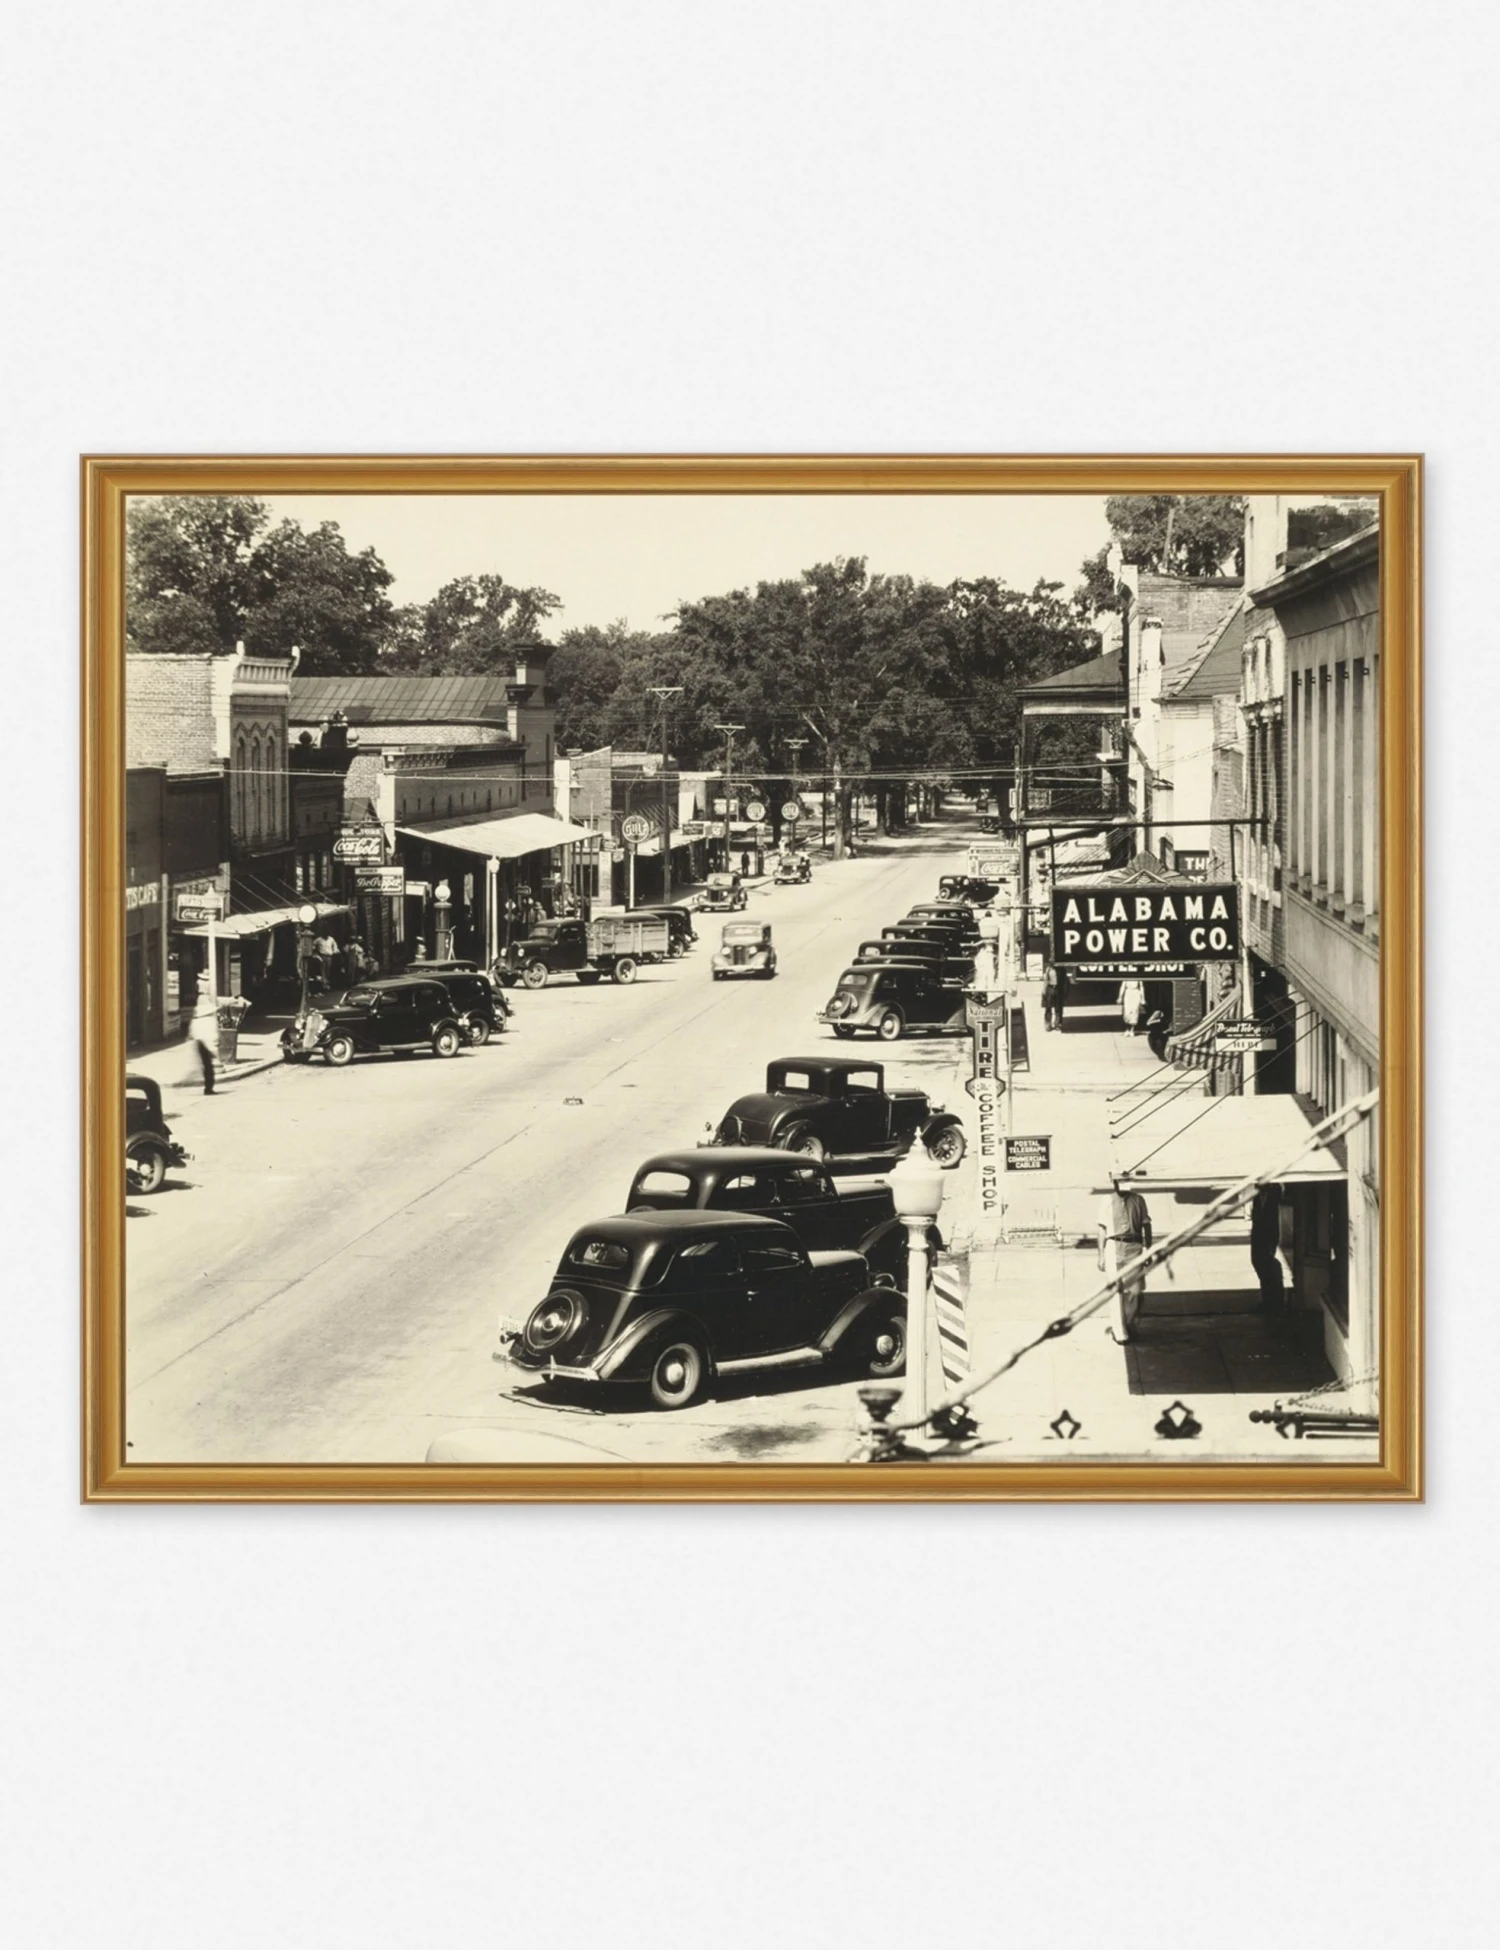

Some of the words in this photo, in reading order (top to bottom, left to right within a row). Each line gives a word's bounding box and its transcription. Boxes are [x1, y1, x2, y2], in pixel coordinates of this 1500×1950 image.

[624, 822, 648, 836] GULF
[1063, 895, 1229, 923] ALABAMA
[1064, 928, 1170, 954] POWER
[1190, 927, 1233, 951] CO.
[966, 1006, 1003, 1017] National
[976, 1020, 993, 1079] TIRE
[978, 1093, 994, 1156] COFFEE
[1008, 1155, 1047, 1163] COMMERCIAL
[1015, 1161, 1041, 1169] CABLES
[982, 1165, 998, 1212] SHOP
